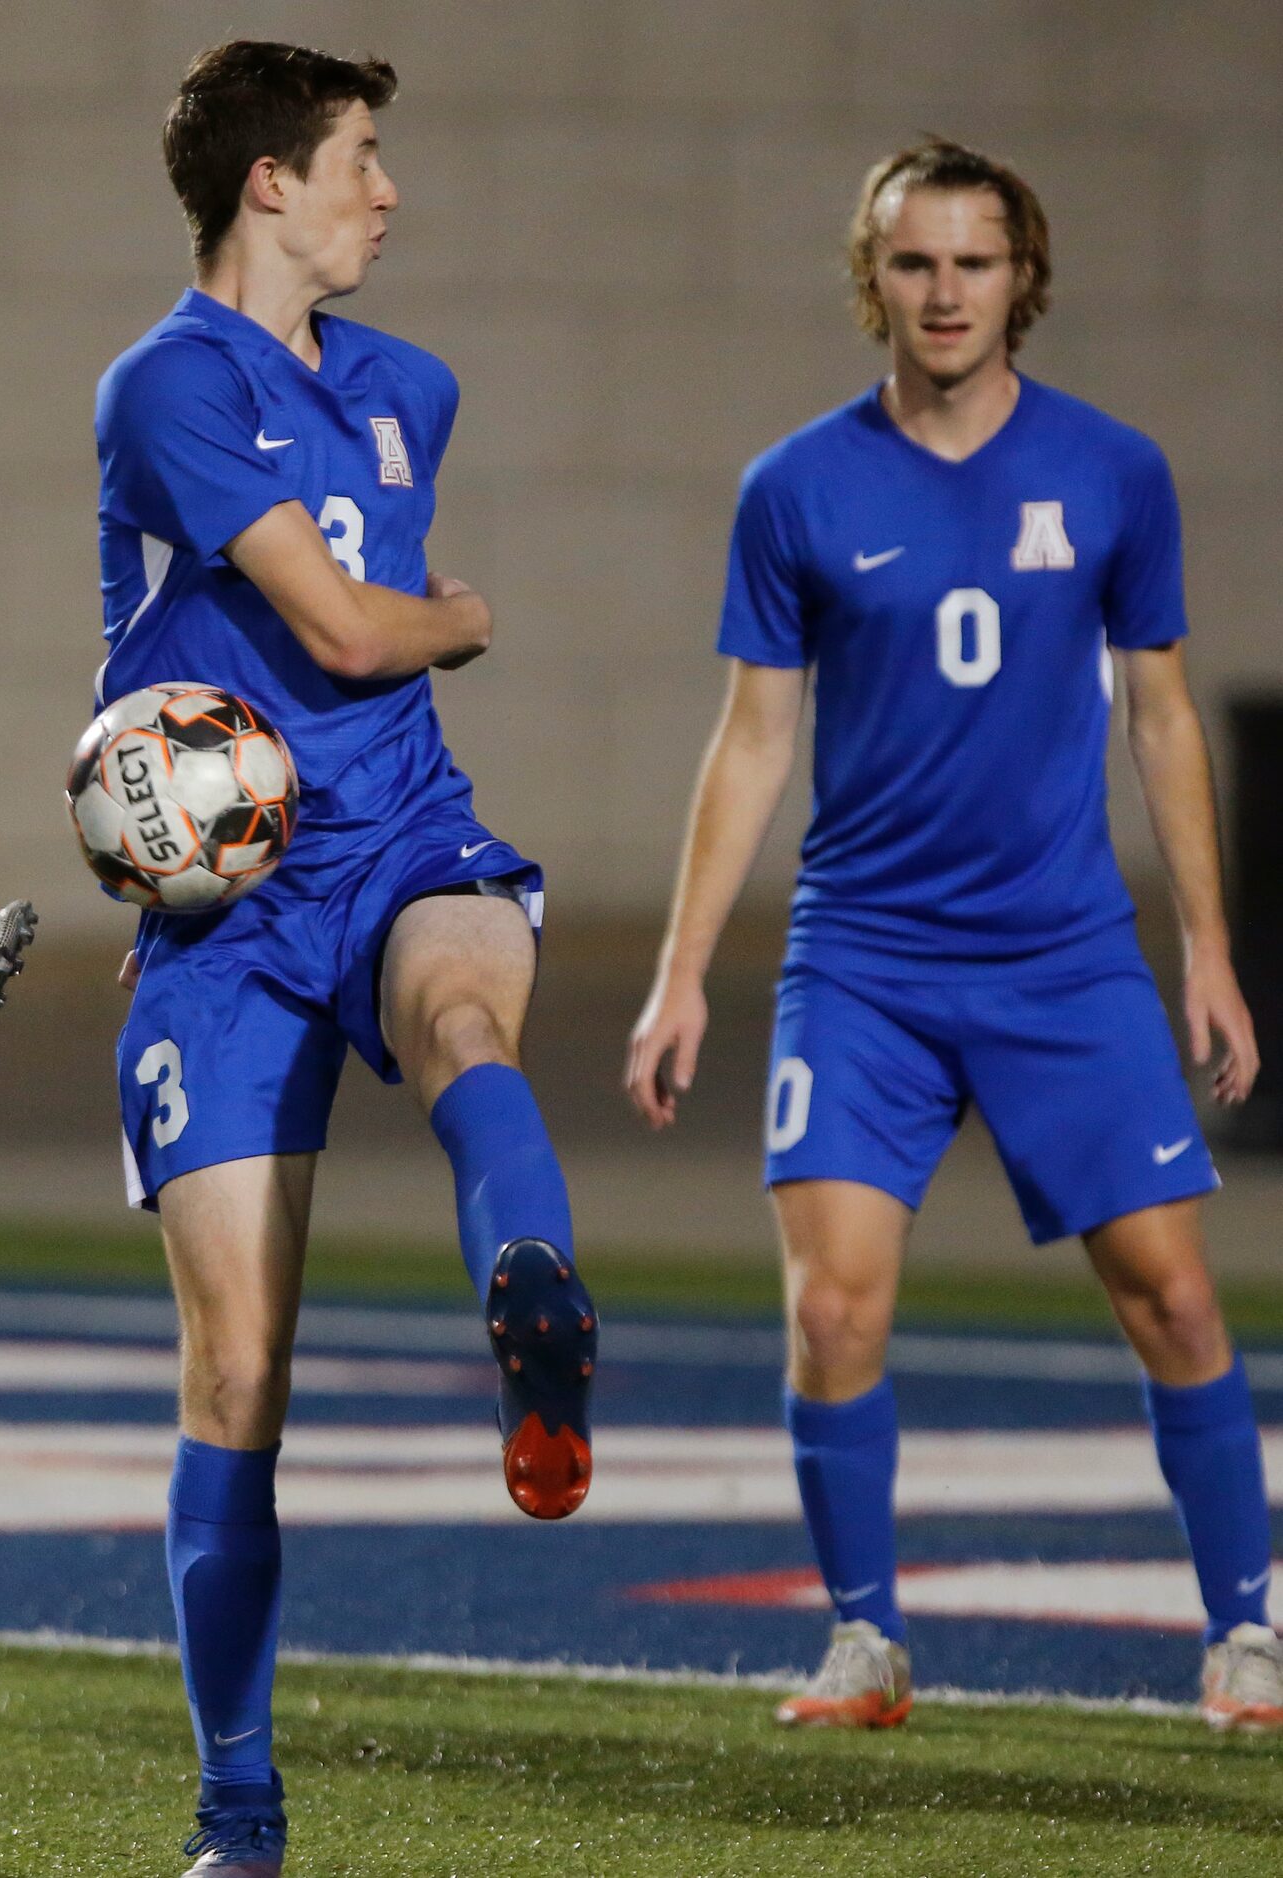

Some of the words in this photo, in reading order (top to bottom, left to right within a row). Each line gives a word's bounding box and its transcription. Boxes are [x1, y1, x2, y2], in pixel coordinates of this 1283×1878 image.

[936, 587, 1002, 688] 0
[118, 746, 181, 862] SELECT
[135, 1038, 189, 1149] 3
[766, 1056, 813, 1154] 0
